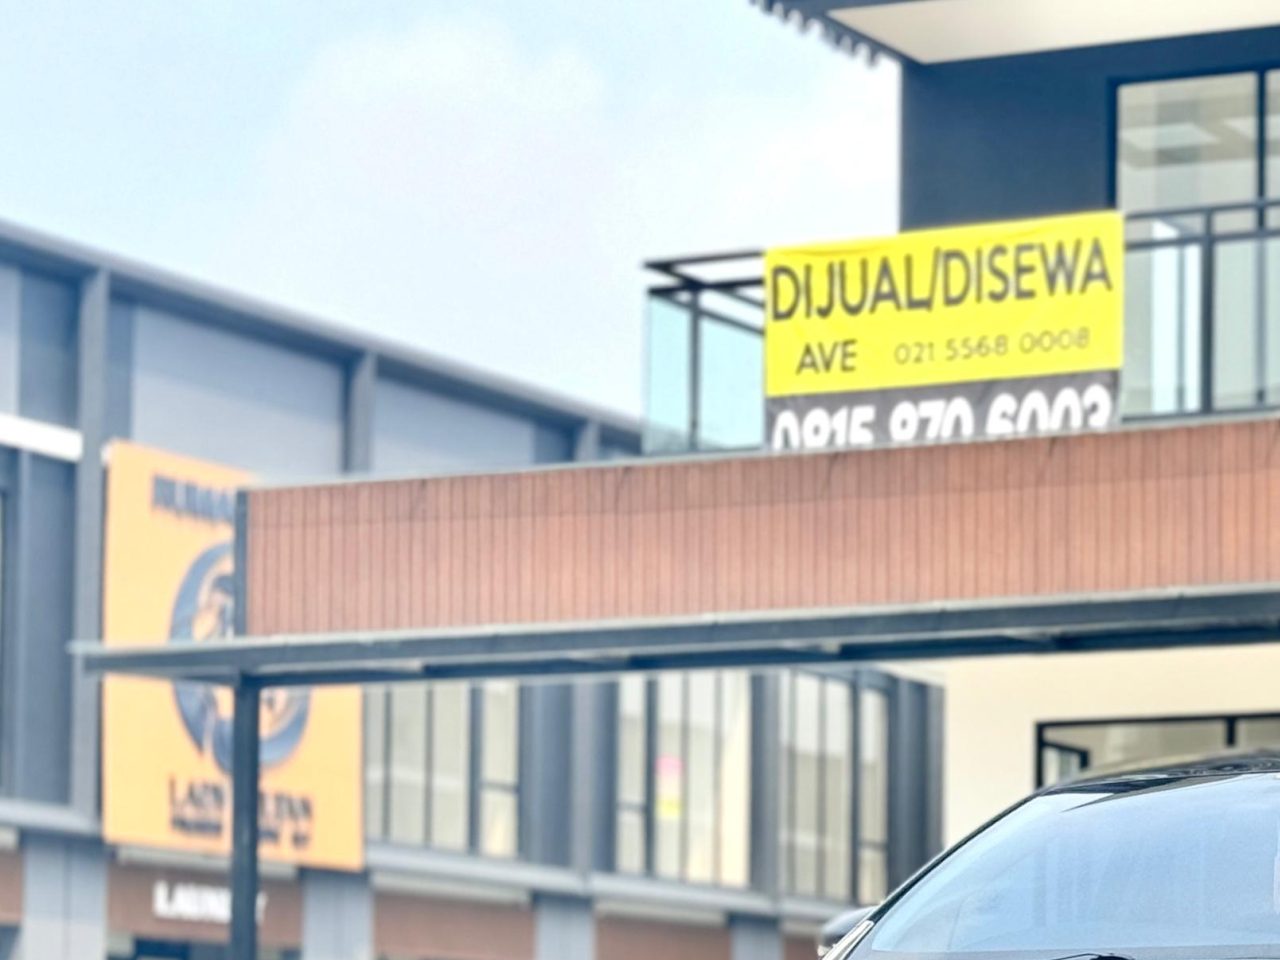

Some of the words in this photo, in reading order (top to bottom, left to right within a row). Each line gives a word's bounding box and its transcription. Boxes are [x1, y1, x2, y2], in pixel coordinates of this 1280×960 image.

[770, 237, 1113, 321] DIJUAL/DISEWA
[796, 339, 857, 375] AVE
[894, 342, 935, 366] 021
[945, 333, 1009, 363] 5568
[1019, 326, 1090, 355] 0008
